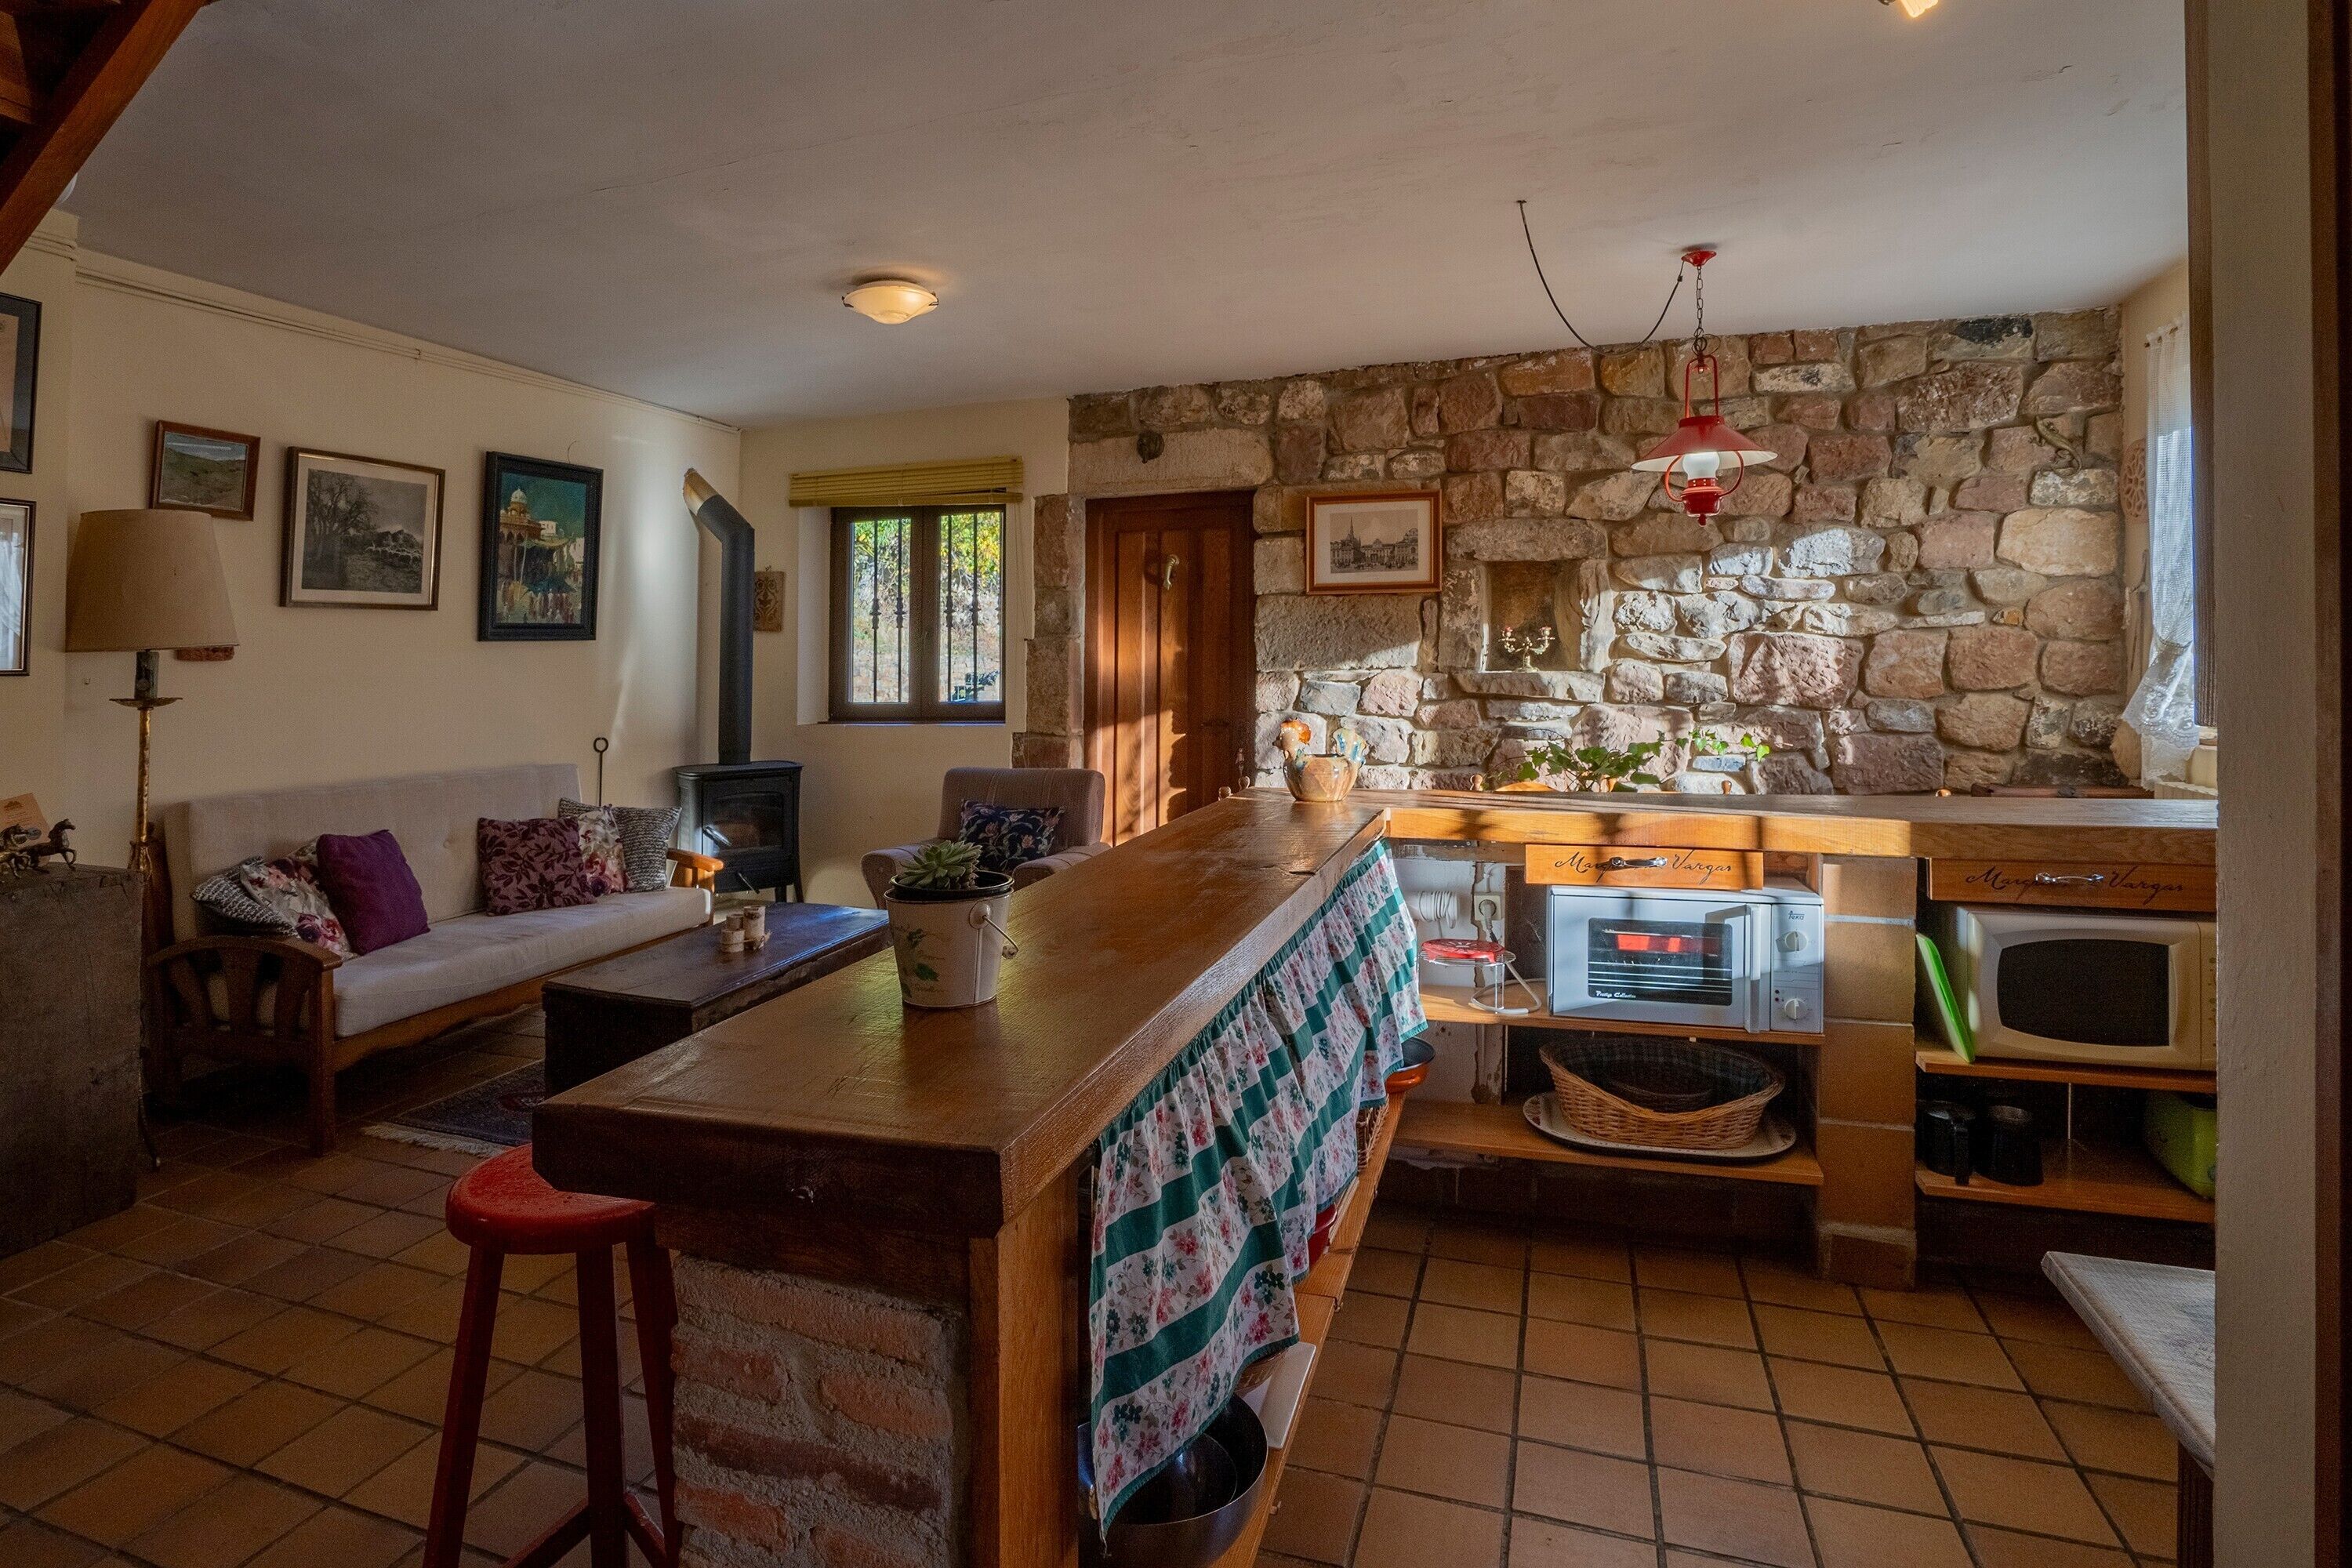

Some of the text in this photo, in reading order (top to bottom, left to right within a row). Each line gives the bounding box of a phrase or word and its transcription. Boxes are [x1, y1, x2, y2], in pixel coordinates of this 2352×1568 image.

[1555, 849, 1732, 885] Marq Vargas
[1965, 866, 2183, 905] Marq Vargas
